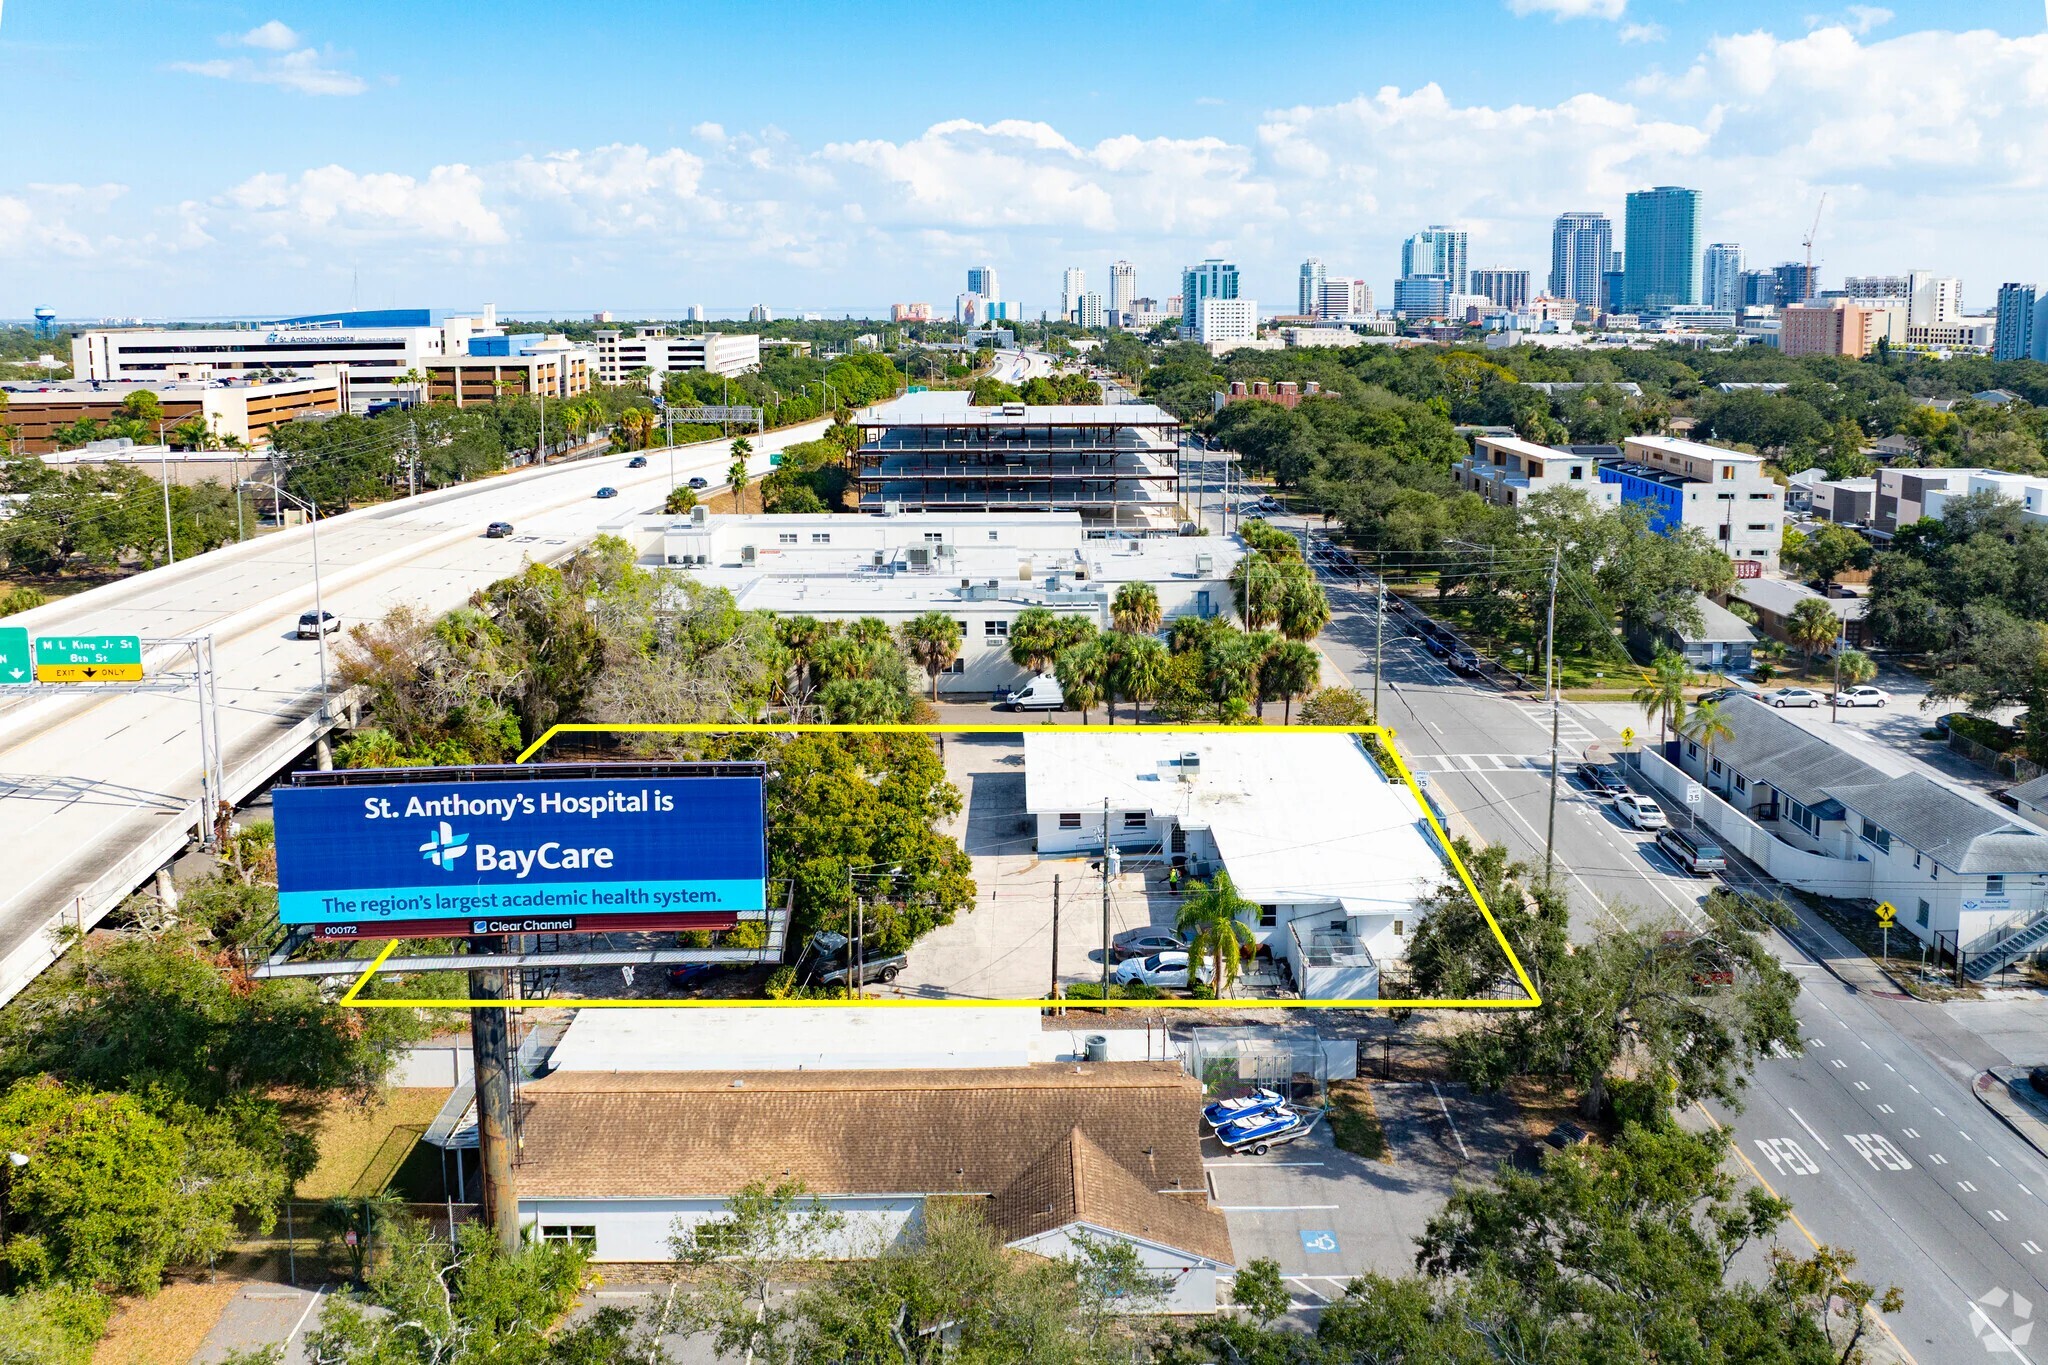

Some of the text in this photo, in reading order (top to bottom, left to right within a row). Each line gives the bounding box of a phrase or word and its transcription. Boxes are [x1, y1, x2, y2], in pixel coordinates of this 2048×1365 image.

[290, 335, 325, 344] Anthony's
[326, 335, 355, 344] Hospital
[43, 639, 133, 651] M L King Jr St
[70, 653, 108, 663] 8th St
[56, 669, 75, 677] EXIT
[1688, 794, 1700, 802] 35
[364, 789, 674, 821] St. Anthony's Hospital is
[475, 841, 614, 879] BayCare
[322, 888, 722, 916] The region's largest academic health system.
[324, 925, 358, 936] 000172
[489, 918, 573, 933] Clear Channel
[1754, 1137, 1820, 1176] PED
[1843, 1133, 1913, 1171] PED
